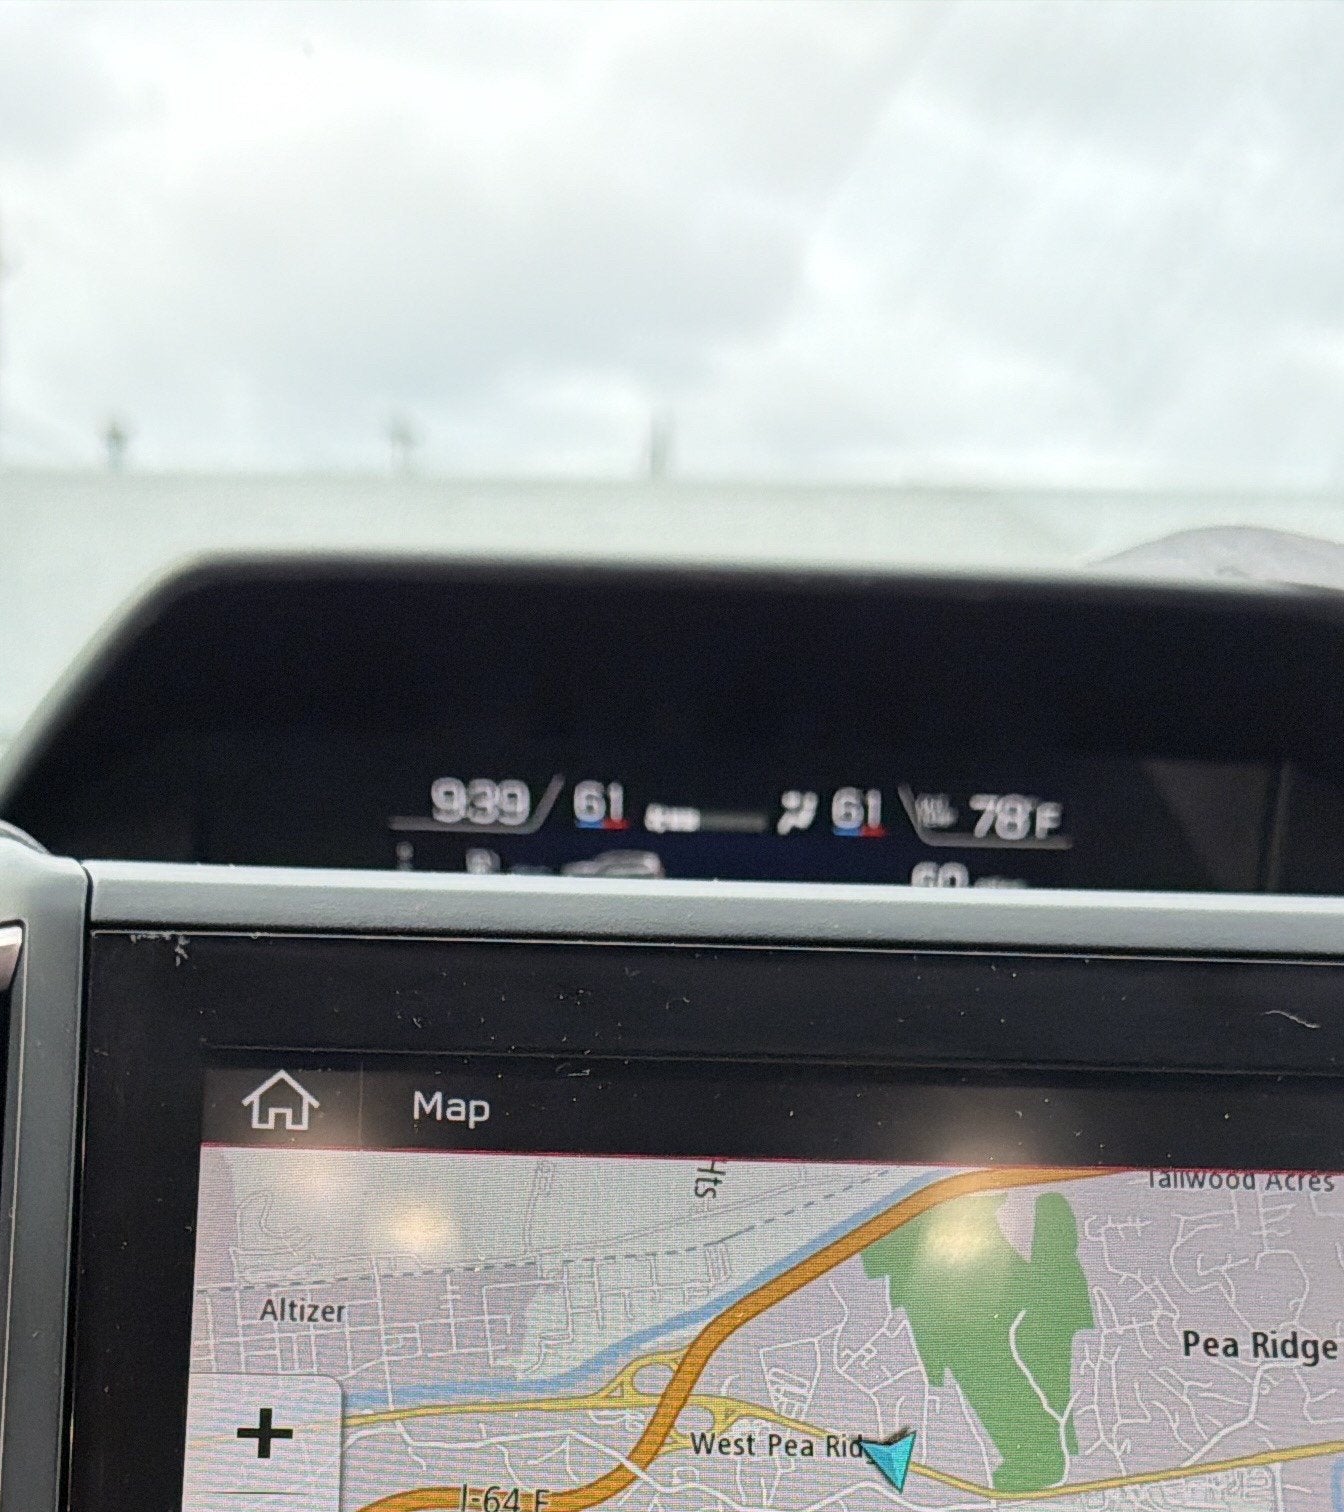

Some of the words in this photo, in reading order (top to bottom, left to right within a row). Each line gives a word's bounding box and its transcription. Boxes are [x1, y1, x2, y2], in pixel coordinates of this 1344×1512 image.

[573, 779, 624, 823] 61
[831, 786, 882, 829] 61
[414, 1092, 491, 1129] Map
[1265, 1173, 1335, 1192] Acres
[259, 1297, 346, 1323] Altizer
[1183, 1330, 1239, 1357] Pea
[1251, 1330, 1338, 1367] Ridge
[690, 1431, 756, 1456] West
[768, 1434, 814, 1457] Pea
[826, 1433, 869, 1461] Rid
